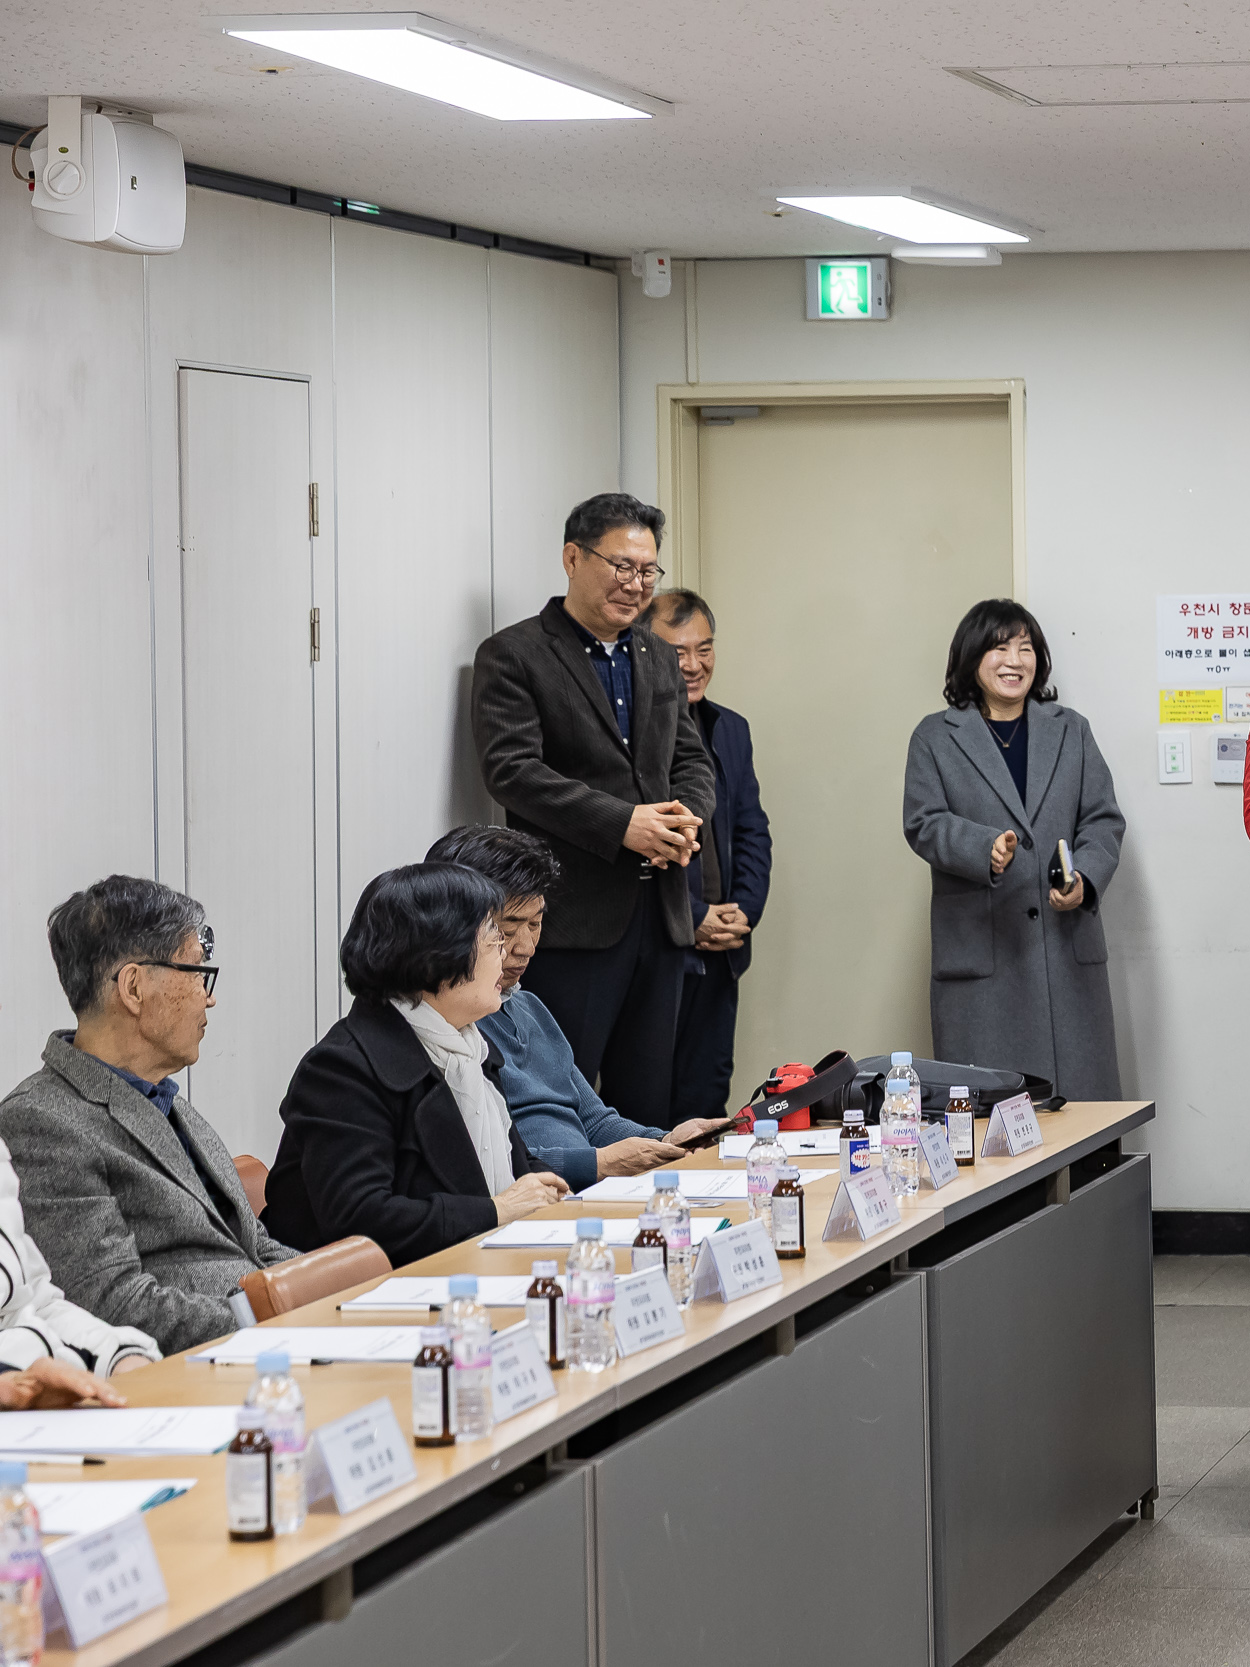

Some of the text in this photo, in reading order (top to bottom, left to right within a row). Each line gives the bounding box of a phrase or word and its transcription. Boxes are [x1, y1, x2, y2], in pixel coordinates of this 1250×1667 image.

[1179, 603, 1220, 617] 우천시
[1187, 626, 1249, 640] 개방 금지
[768, 1100, 789, 1115] EOS
